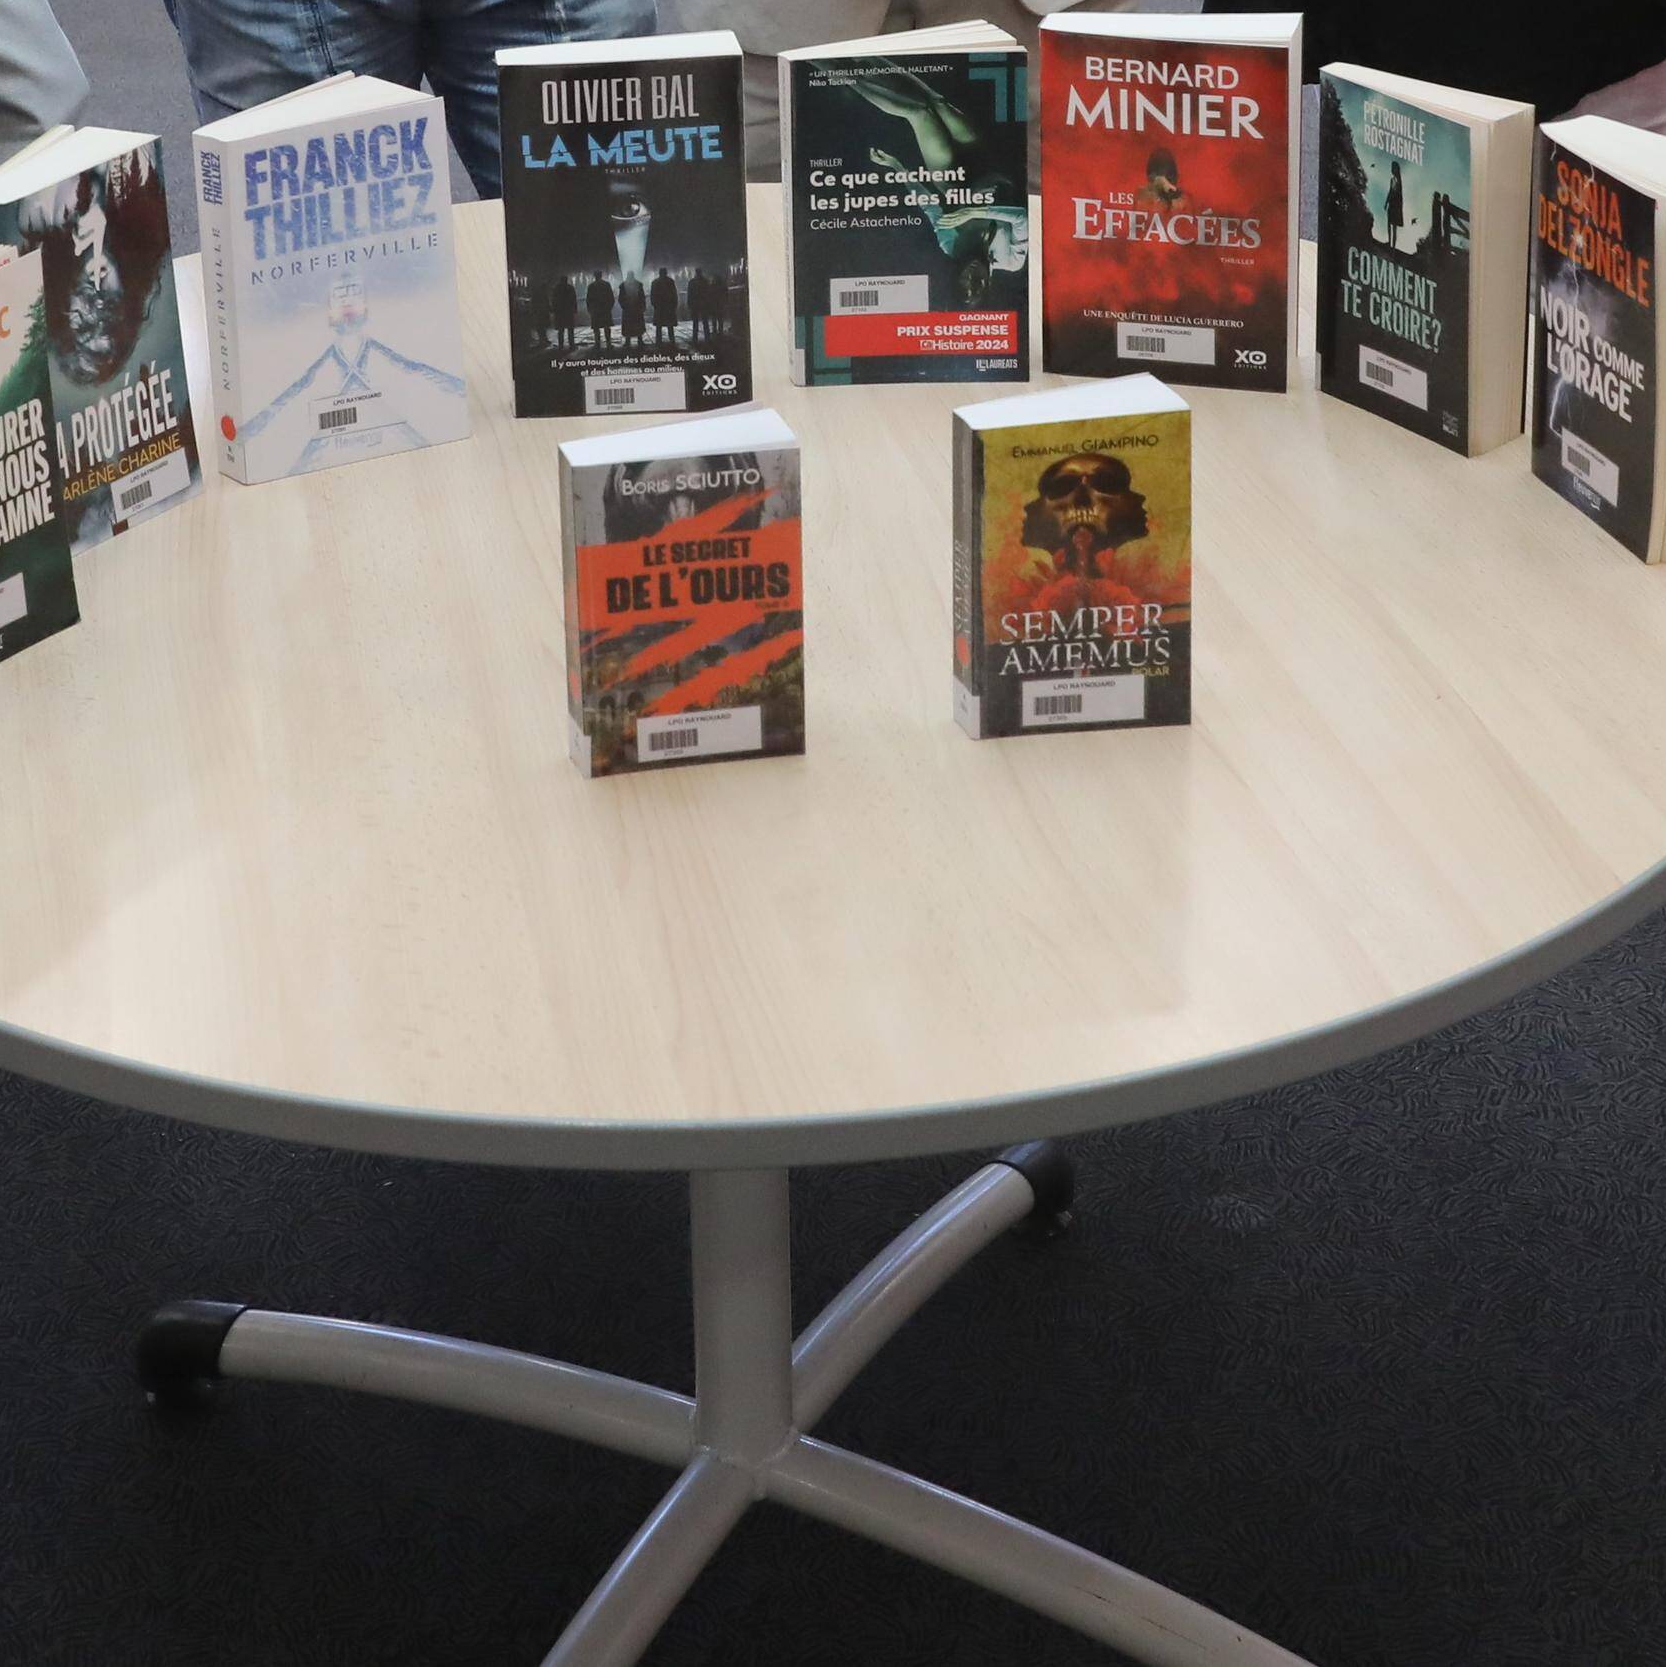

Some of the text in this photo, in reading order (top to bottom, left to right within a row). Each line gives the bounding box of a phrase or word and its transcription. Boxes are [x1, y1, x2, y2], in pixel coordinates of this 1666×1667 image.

[1085, 56, 1239, 90] BERNARD
[541, 74, 700, 125] OLIVIER BAL
[1066, 84, 1264, 139] MINIER
[244, 117, 433, 207] FRANCK
[521, 125, 724, 169] LA MEUTE
[809, 158, 843, 168] THRILLER
[1363, 123, 1424, 167] ROSTAGNAT
[200, 150, 214, 204] FRANCK
[211, 153, 223, 206] THILLIEZ
[809, 166, 966, 190] Ce que cachent
[1109, 192, 1134, 205] LES
[244, 172, 437, 261] THILLIEZ
[810, 188, 995, 213] les jupes des filles
[810, 214, 922, 230] Cécile Astachenko
[1556, 161, 1623, 241] SONIA
[1071, 197, 1263, 249] EFFACÉES
[251, 233, 438, 285] NORFERVILLE
[1537, 193, 1651, 308] DELZONGLE
[1341, 279, 1362, 318] TE
[1347, 246, 1438, 314] COMMENT
[896, 324, 1009, 337] PRIX SUSPENSE
[959, 313, 1009, 322] GAGNANT
[1083, 309, 1103, 318] UNE
[1105, 311, 1148, 322] ENQUÊTE
[1150, 314, 1163, 322] DE
[1193, 317, 1244, 328] GUERRERO
[1540, 285, 1645, 391] NOIR COMME
[558, 361, 564, 370] y
[587, 358, 622, 368] toujours
[623, 355, 639, 364] des
[674, 353, 690, 362] des
[691, 352, 715, 361] dieux
[933, 339, 974, 351] Histoire
[975, 339, 1010, 350] 2024
[590, 367, 606, 376] des
[607, 367, 643, 376] hommes
[1546, 332, 1632, 424] L'ORAGE
[70, 360, 178, 471] PROTÉGÉE
[1081, 434, 1159, 451] GIAMPINO
[62, 463, 116, 502] ARLÈNE
[117, 432, 183, 479] CHARINE
[622, 468, 760, 496] BORIS SCIUTTO
[643, 537, 751, 567] LE SECRET
[606, 562, 790, 614] DE L'OURS
[999, 603, 1169, 646] SEMPER
[998, 636, 1171, 676] AMEMUS
